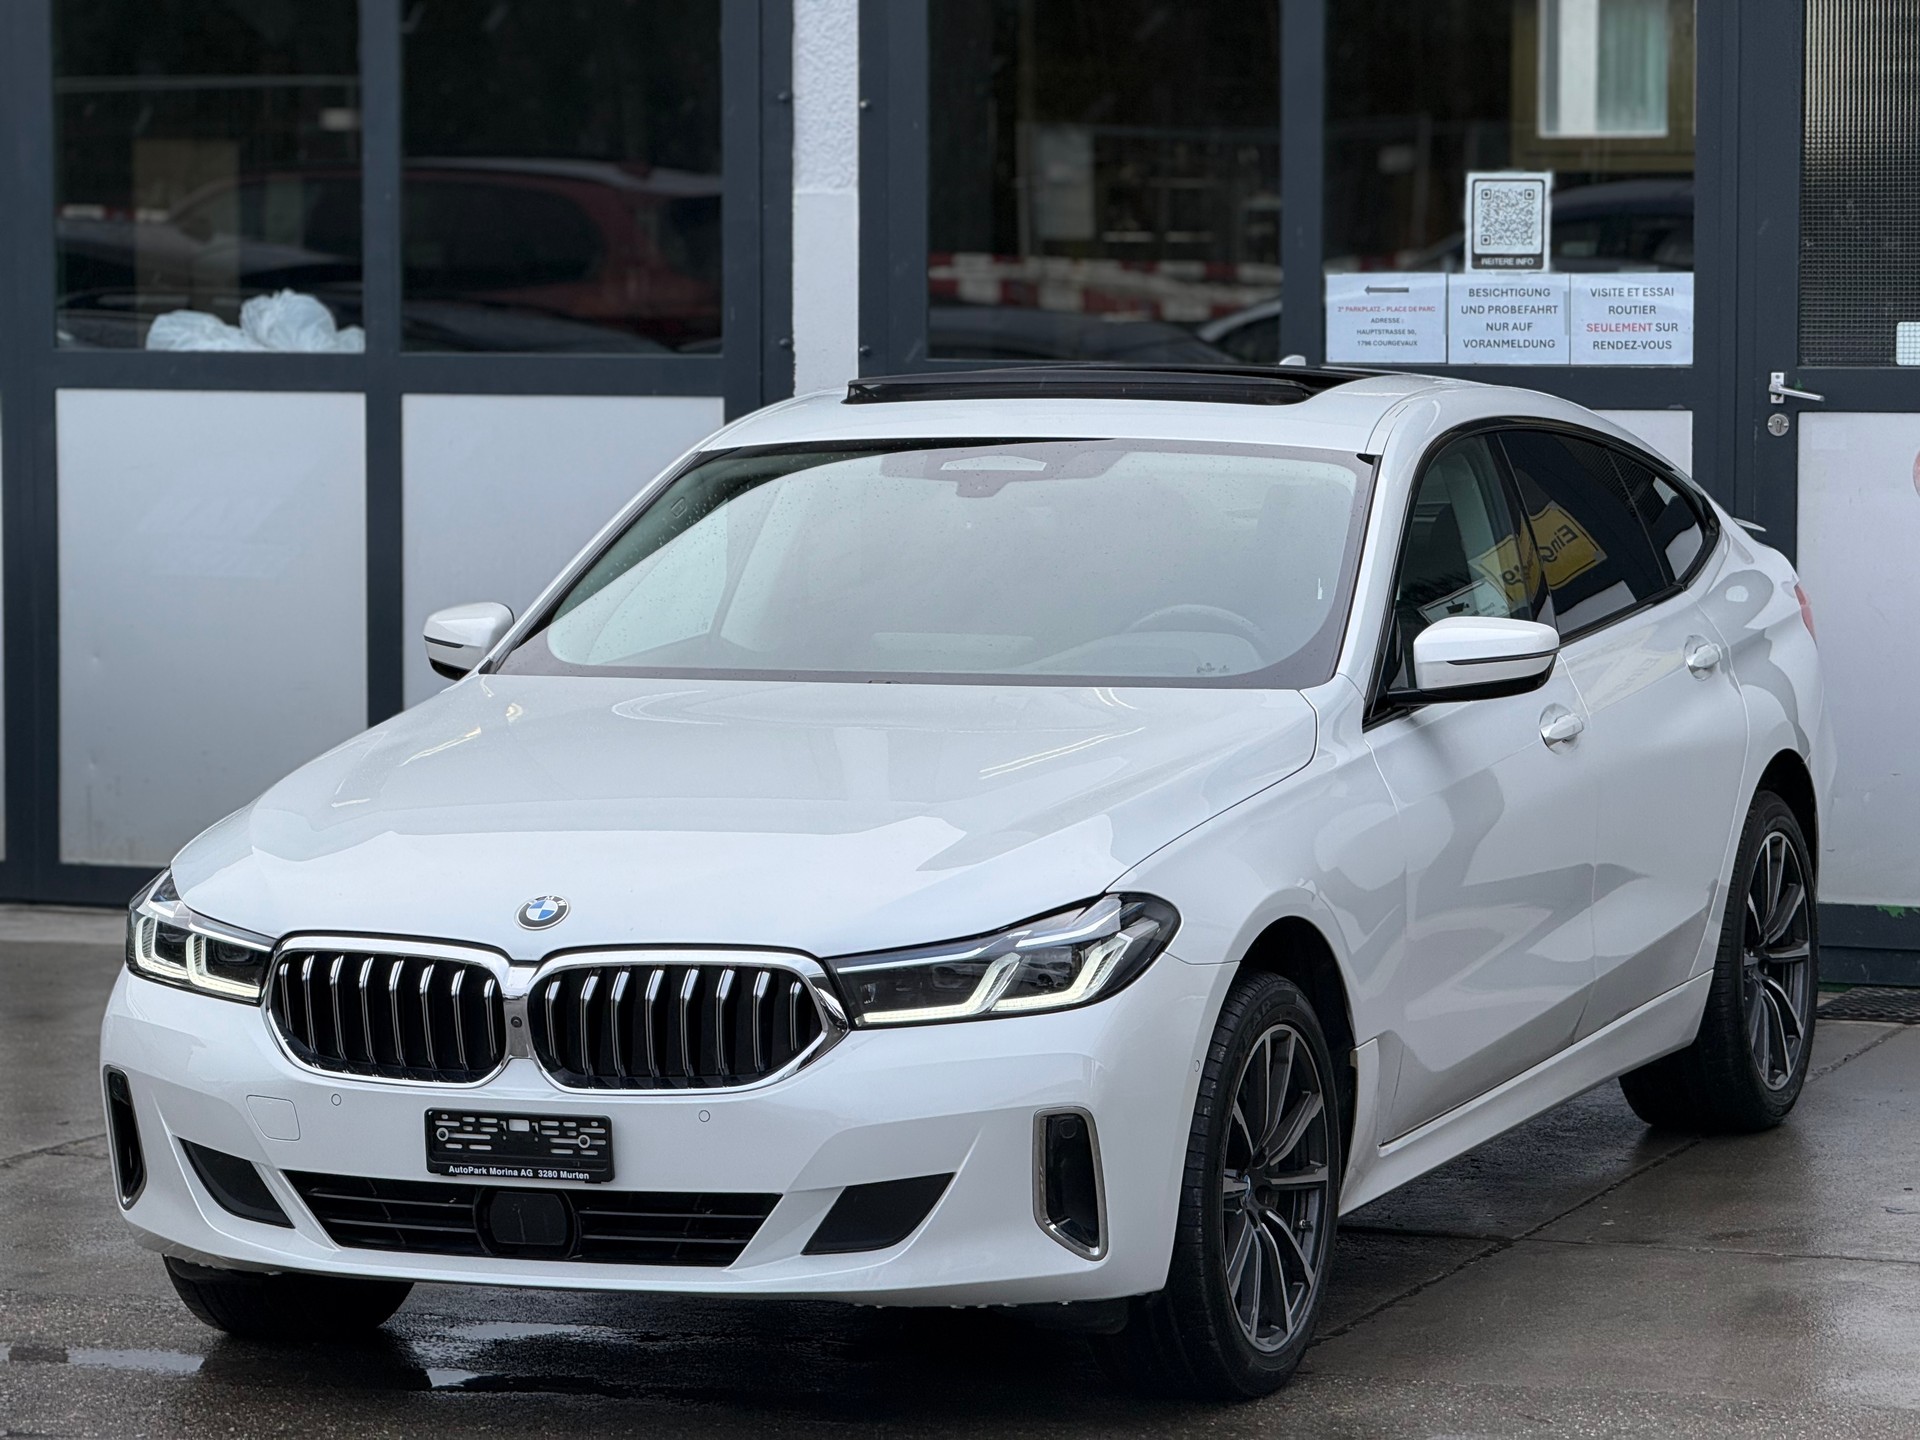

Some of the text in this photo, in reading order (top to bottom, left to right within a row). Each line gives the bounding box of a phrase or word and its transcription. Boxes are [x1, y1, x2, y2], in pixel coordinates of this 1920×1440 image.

[1516, 257, 1534, 265] INFO
[1468, 288, 1551, 297] BESICHTIGUNG
[1590, 287, 1674, 297] VISITE ET ESSAI
[1461, 305, 1558, 314] UND PROBEFAHRT
[1608, 305, 1656, 315] ROUTIER
[1486, 322, 1533, 331] NUR AUF
[1586, 323, 1678, 332] SEULEMENT SUR
[1463, 339, 1556, 348] VORANMELDUNG
[1592, 340, 1672, 350] RENDEZ-VOUS
[448, 1165, 590, 1180] AutoPark Morina AG 3280 Murten
